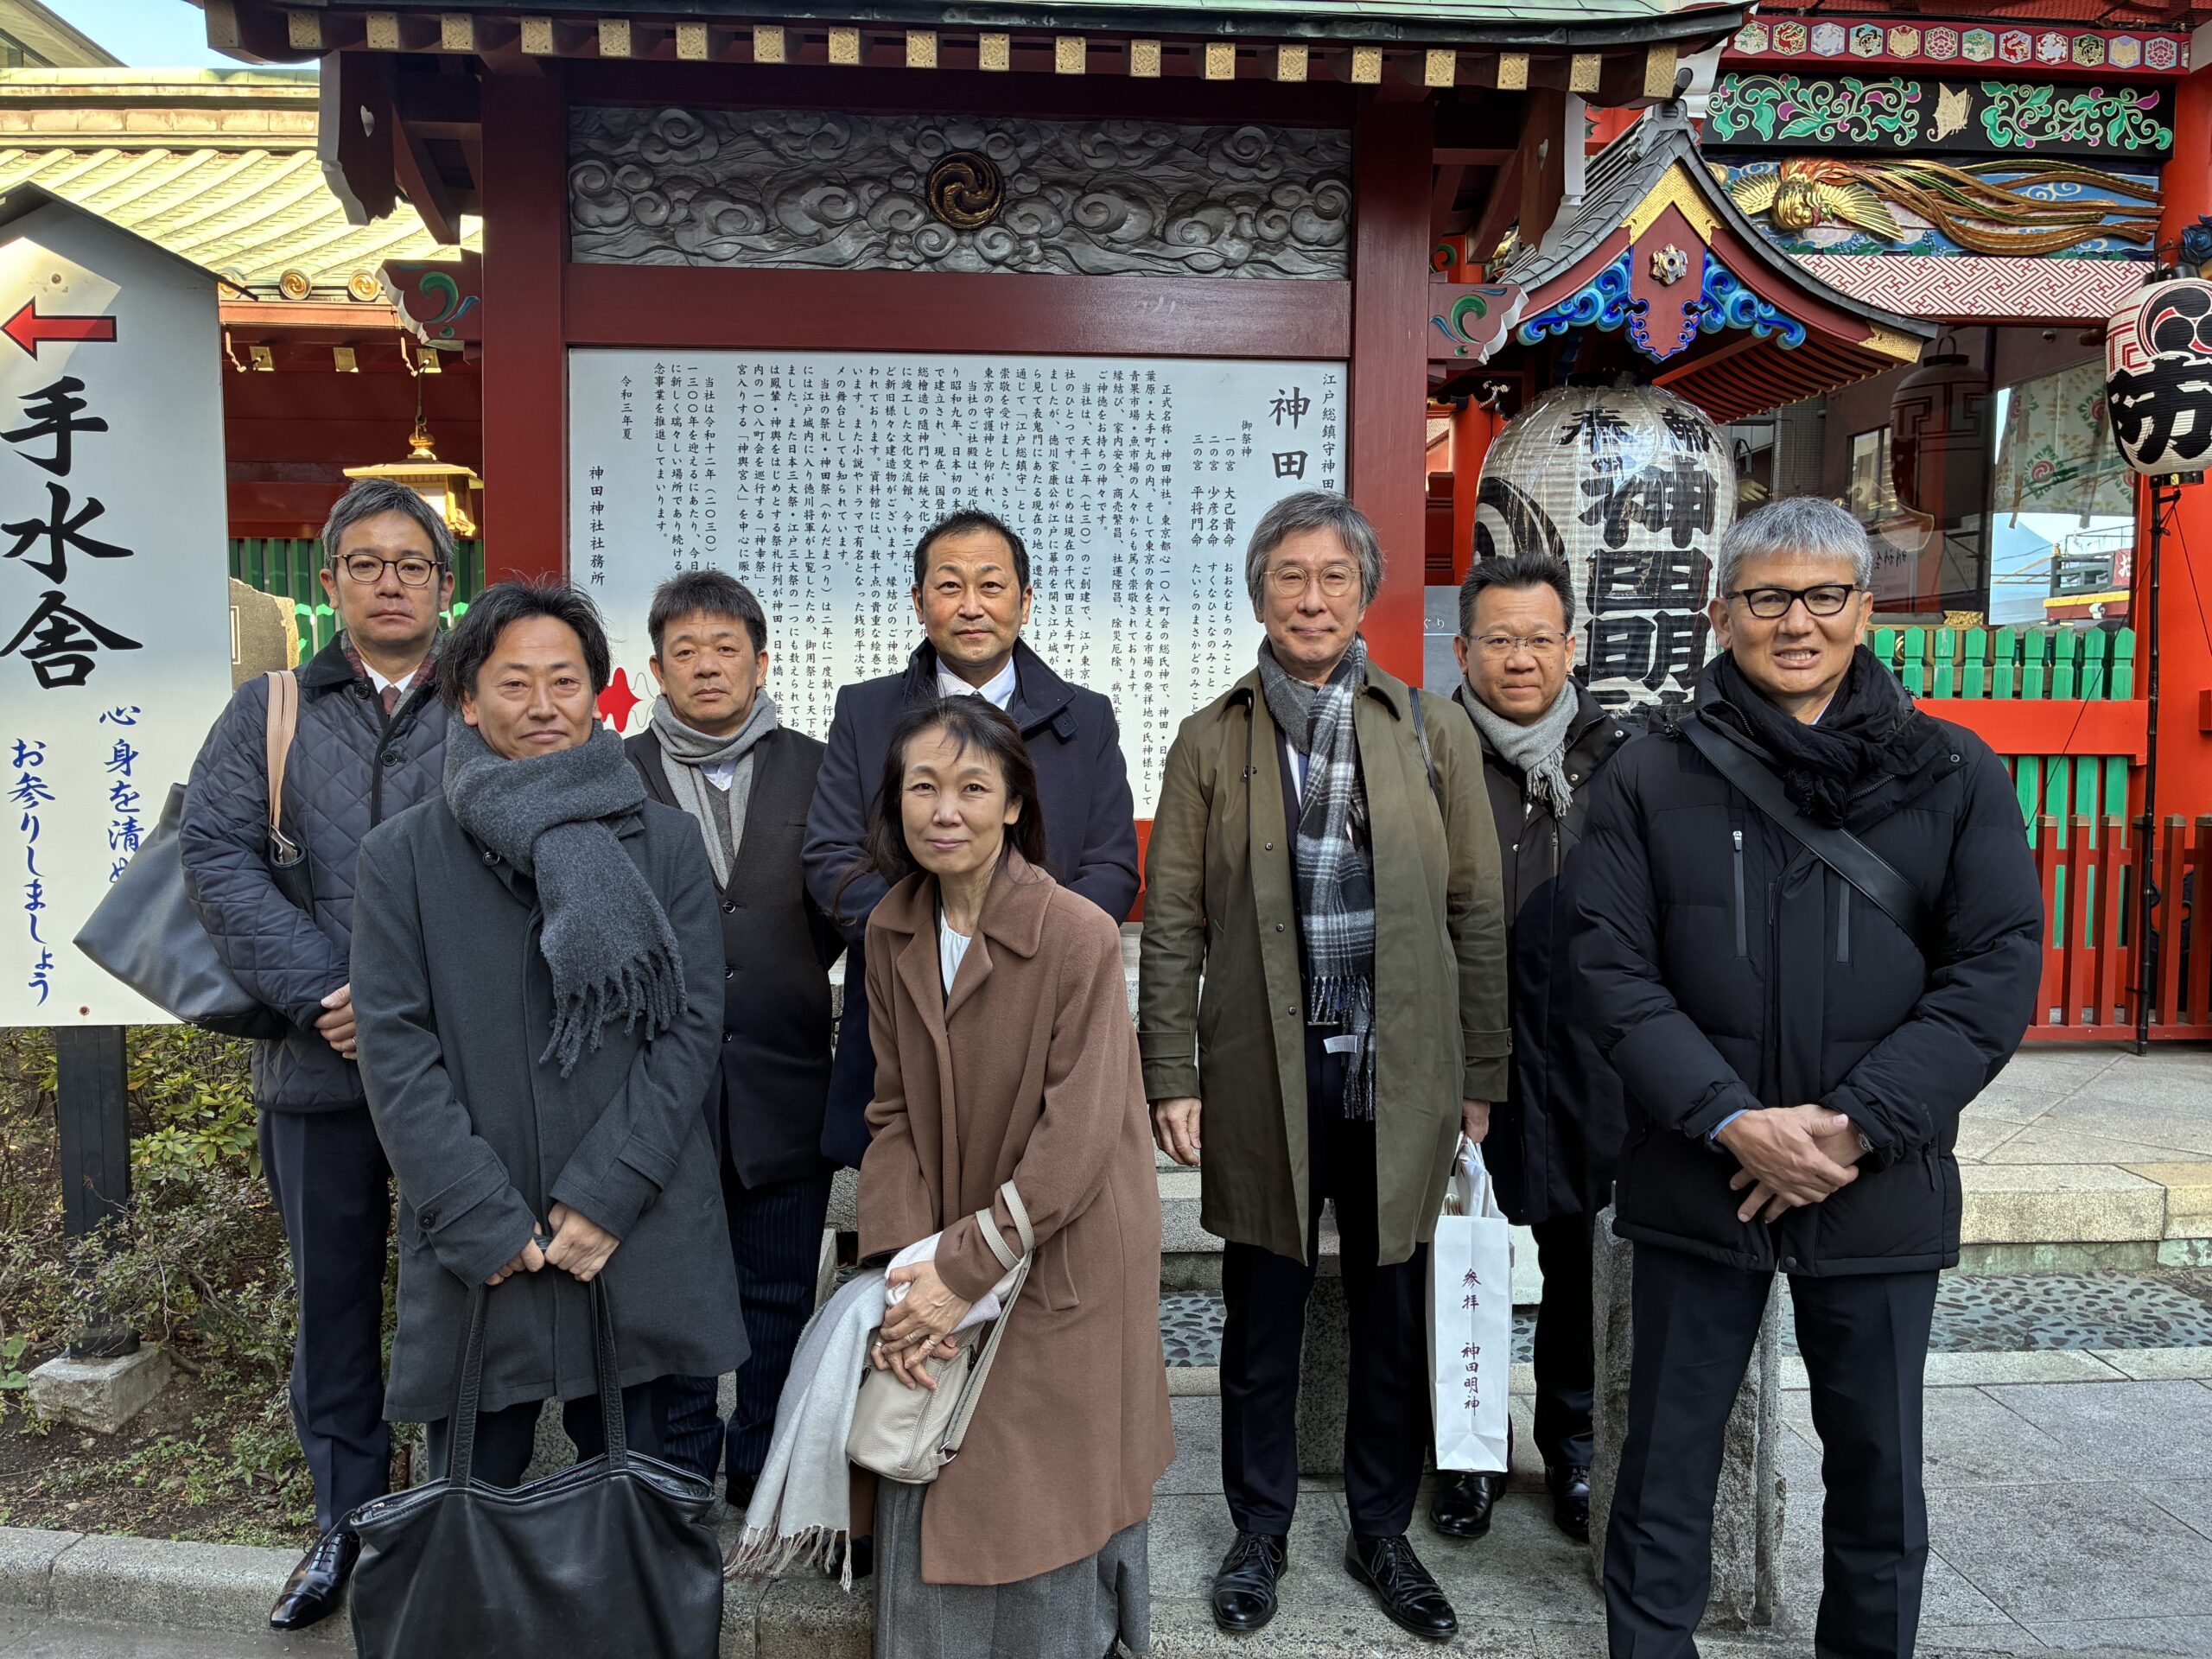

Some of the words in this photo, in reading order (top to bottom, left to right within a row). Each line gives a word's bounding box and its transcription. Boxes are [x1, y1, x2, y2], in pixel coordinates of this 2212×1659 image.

[621, 376, 632, 440] 令和三年夏
[654, 363, 666, 537] 念事業を推進してまいります。
[671, 365, 683, 570] に新しく瑞々しい場所であり続ける
[688, 367, 700, 571] 一三〇〇年を迎えるにあたり、今日
[704, 377, 716, 571] 当社は令和十二年（二〇三〇）に
[737, 364, 749, 586] 宮入りする「神輿宮入」を中心に賑や
[753, 364, 766, 605] 内の一〇八町会を巡行する「神幸祭」と、
[836, 366, 848, 565] メの舞台としても知られています。
[950, 367, 964, 511] り昭和九年、日本初の本
[983, 367, 995, 502] 東京の守護神と仰がれ、
[997, 368, 1011, 523] 崇敬を受けました。さらに
[1014, 368, 1027, 544] 通じて「江戸総鎮守」として、
[1096, 371, 1108, 530] ご神徳をお持ちの神々です。
[1192, 435, 1204, 471] 三の宮
[1209, 436, 1219, 471] 二の宮
[1225, 438, 1235, 471] 一の宮
[1241, 420, 1252, 457] 御祭神
[1269, 387, 1310, 480] 神田
[1319, 374, 1336, 491] 江戸総鎮守神田
[0, 376, 143, 690] 手水舎
[589, 466, 605, 586] 神田神社社務所
[788, 365, 799, 727] ました。また日本三大祭・江戸三大祭の一つにも数えられてお
[869, 366, 881, 676] われております。資料館には、数千点の貴重な絵巻や
[1030, 369, 1043, 653] ら見て表鬼門にあたる現在の地へ遷座いたしまし
[1048, 369, 1059, 665] ましたが、徳川家康公が江戸に幕府を開き江戸城が
[1064, 369, 1075, 680] 社のひとつです。はじめは現在の千代田区大手町・将
[1128, 371, 1140, 697] 青果市場・魚市場の人々からも篤く崇敬されております。
[1143, 371, 1155, 804] 葉原・大手町丸の内、そして東京の食を支える市場の発祥地の氏神様として
[1191, 486, 1204, 547] 平将門命
[1207, 486, 1219, 547] 少彦名命
[1224, 486, 1236, 547] 大己貴命
[7, 738, 55, 1007] お参りしましょう
[1461, 1268, 1482, 1313] 参拝
[1460, 1342, 1481, 1417] 神田明神
